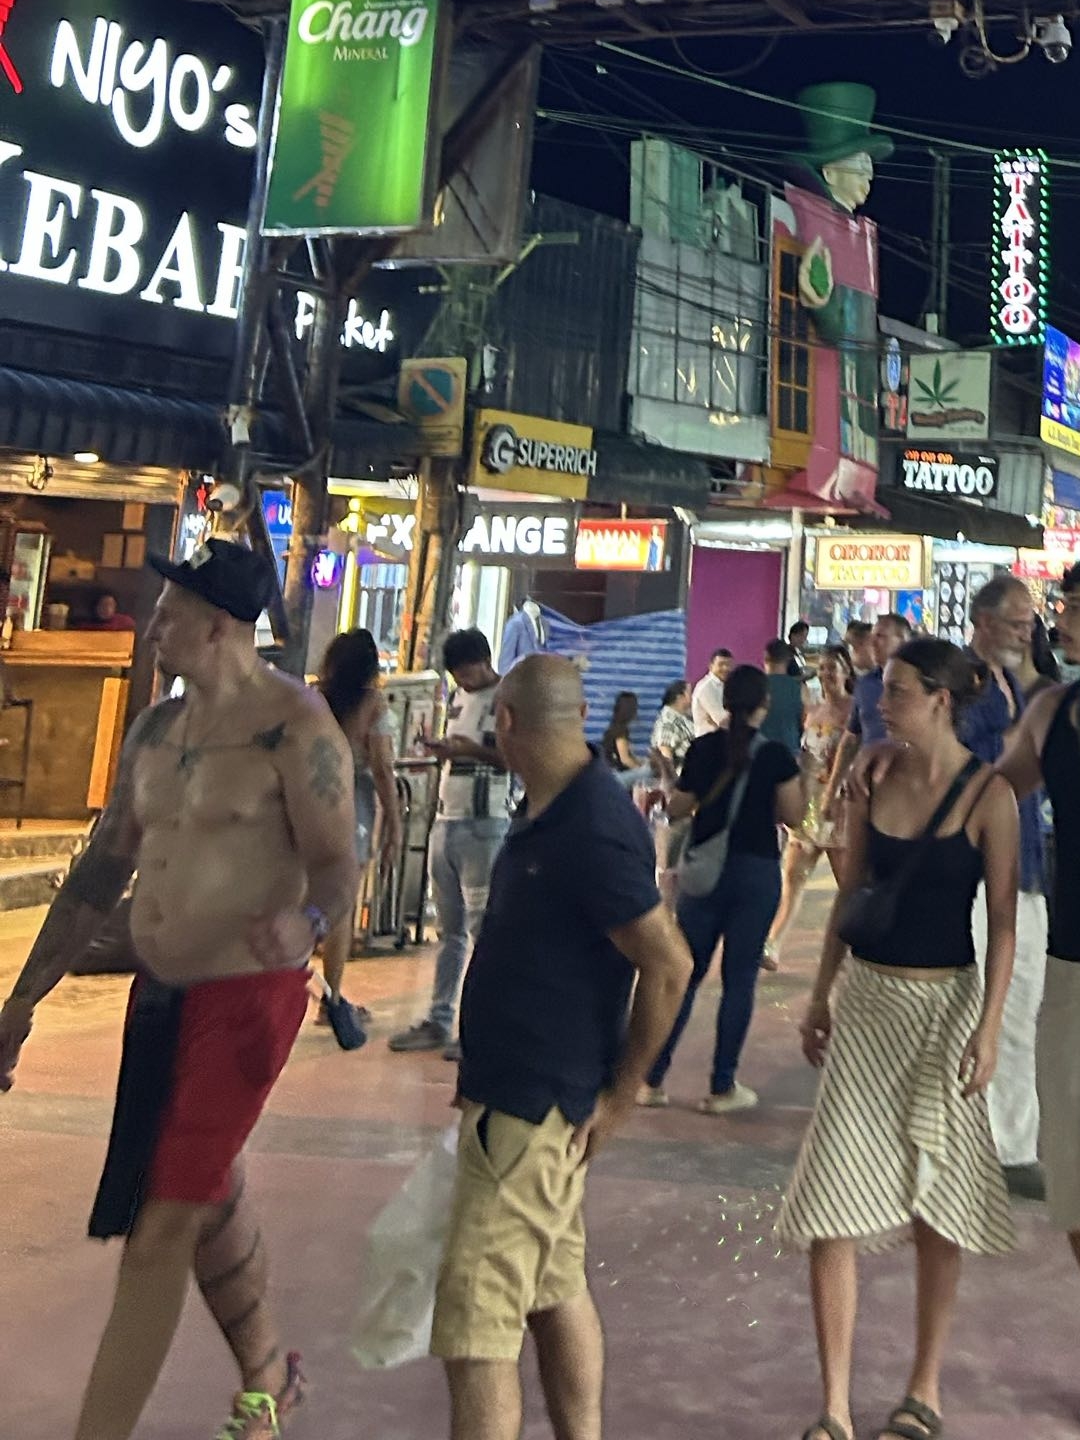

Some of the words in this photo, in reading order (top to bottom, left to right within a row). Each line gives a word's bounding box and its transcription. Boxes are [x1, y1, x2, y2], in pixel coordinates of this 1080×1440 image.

[298, 0, 429, 47] Chang
[295, 290, 394, 353] Pket
[517, 438, 597, 476] SUPERRICH
[903, 459, 994, 495] TATTOO
